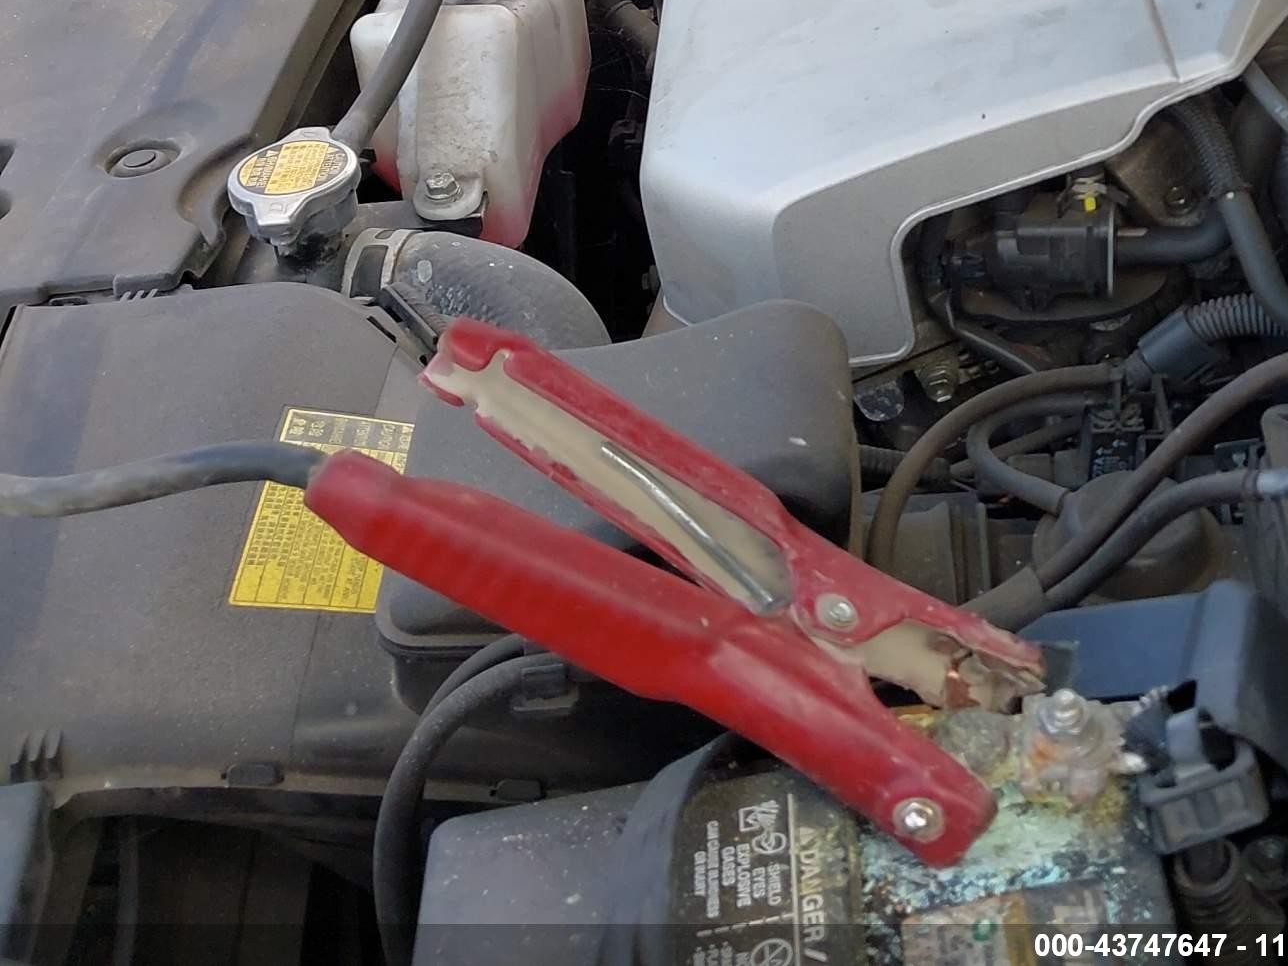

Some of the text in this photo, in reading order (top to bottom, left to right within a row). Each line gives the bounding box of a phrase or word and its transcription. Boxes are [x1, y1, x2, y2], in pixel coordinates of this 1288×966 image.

[706, 820, 720, 918] CAN CAUSE BLINDNESS
[722, 846, 735, 886] GASES
[736, 843, 751, 908] EXPLOSIVE
[753, 866, 765, 898] EYES
[768, 863, 782, 905] SHIELD
[799, 849, 825, 942] DANGER
